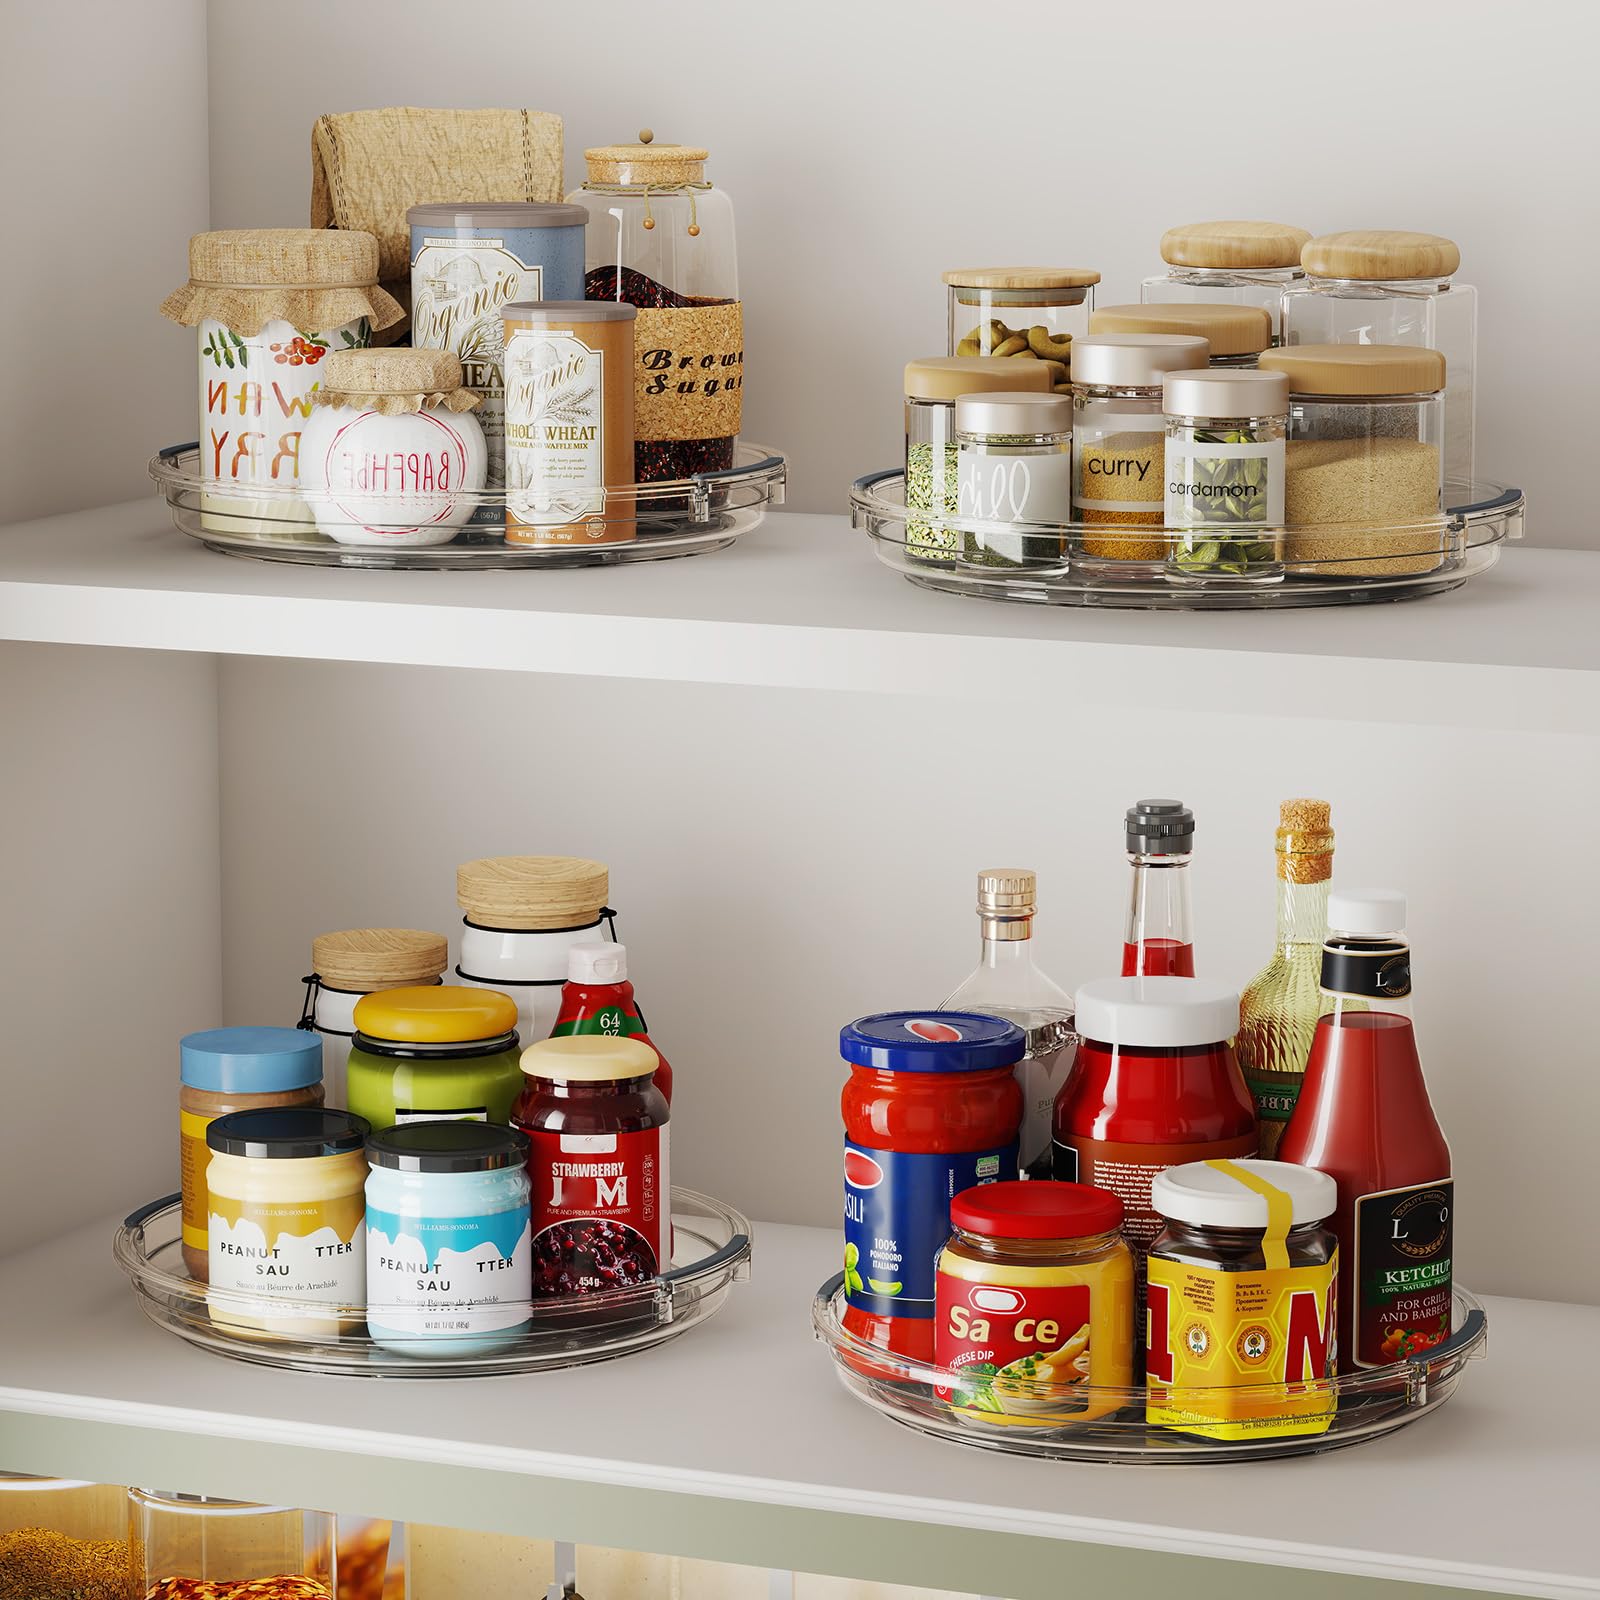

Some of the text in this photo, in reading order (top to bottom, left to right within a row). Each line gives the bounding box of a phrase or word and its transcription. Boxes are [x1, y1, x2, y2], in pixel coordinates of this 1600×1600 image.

[414, 271, 519, 350] Organic
[505, 352, 586, 418] Organic
[505, 422, 541, 440] WHOLE
[544, 425, 598, 441] WHEAT
[544, 442, 573, 451] WAFFLE
[573, 442, 589, 451] MIX
[1088, 458, 1151, 481] curry
[1169, 481, 1257, 498] cardamon
[599, 1012, 621, 1029] 64
[551, 1162, 625, 1178] STRAWBERRY
[572, 1209, 598, 1217] PREMIUM
[598, 1207, 632, 1216] STRAWBERRY
[1396, 1197, 1422, 1217] QUALITY
[220, 1241, 281, 1259] PEANUT
[874, 1237, 897, 1252] 100%
[869, 1249, 903, 1263] POMODORO
[379, 1256, 442, 1275] PEANUT
[872, 1259, 899, 1272] ITALIANO
[1384, 1258, 1450, 1285] KETCHUP
[294, 1282, 305, 1291] de
[1381, 1286, 1400, 1294] 100%
[1402, 1281, 1433, 1292] NATURAL
[1396, 1291, 1447, 1311] FOR GRILL
[1379, 1312, 1409, 1323] AND
[949, 1350, 995, 1370] CHEESE DIP
